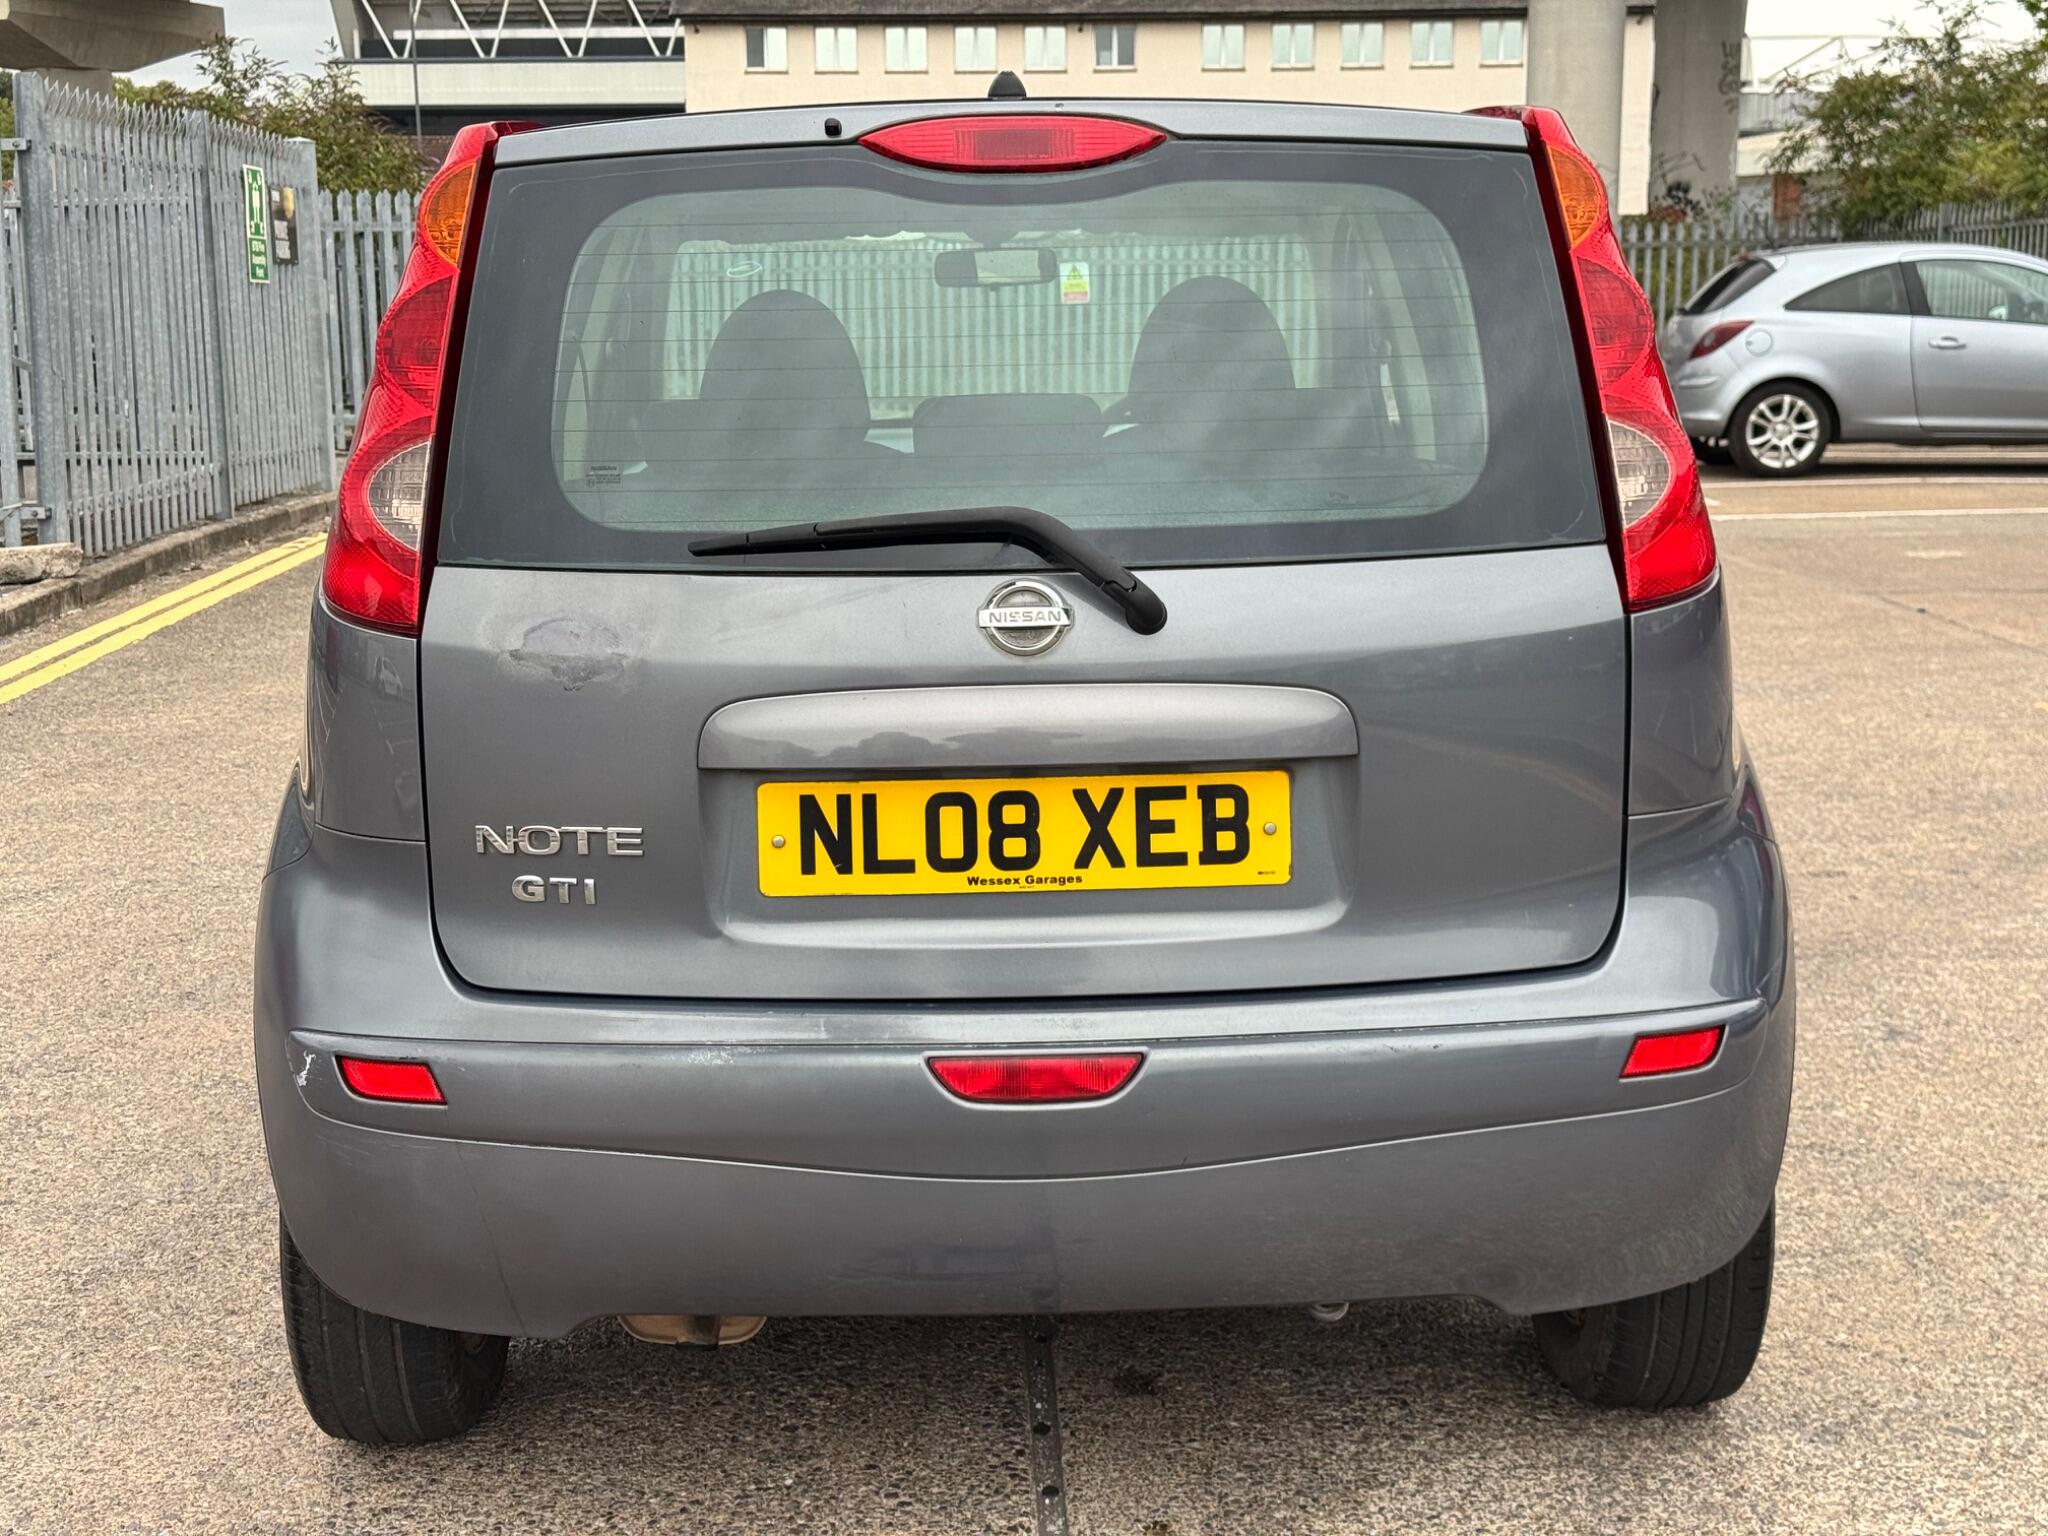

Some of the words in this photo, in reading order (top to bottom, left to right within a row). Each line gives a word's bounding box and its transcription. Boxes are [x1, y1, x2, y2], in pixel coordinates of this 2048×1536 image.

[989, 610, 1061, 623] NISSAN
[475, 825, 644, 856] NOTE
[799, 791, 1041, 875] NL08
[1072, 783, 1250, 870] XEB
[512, 875, 596, 905] GTI
[967, 876, 1020, 886] Wessex
[1025, 875, 1083, 887] Garages
